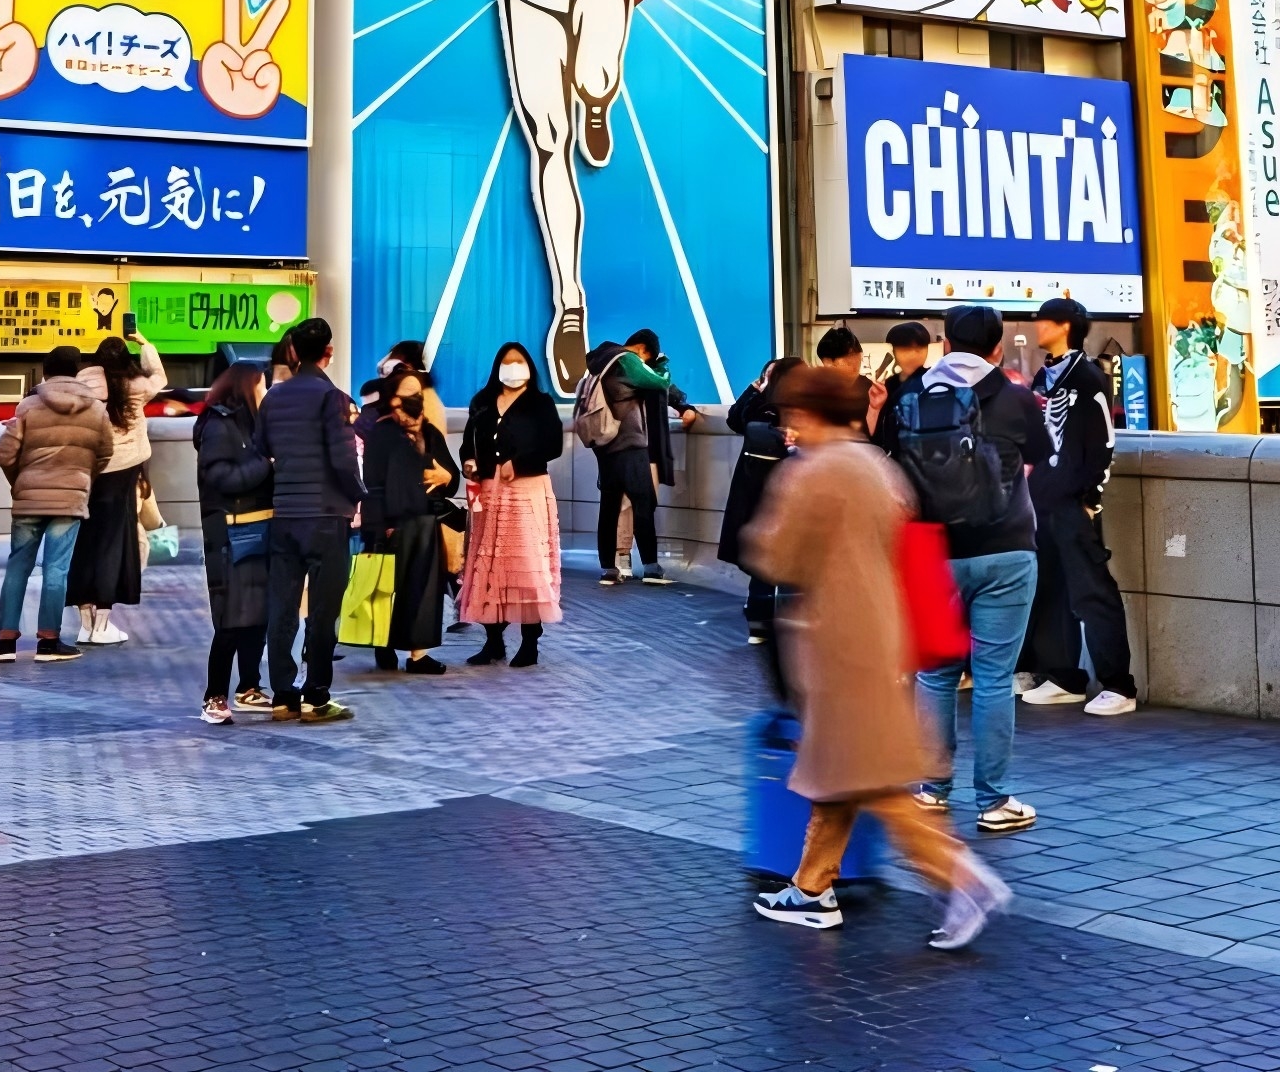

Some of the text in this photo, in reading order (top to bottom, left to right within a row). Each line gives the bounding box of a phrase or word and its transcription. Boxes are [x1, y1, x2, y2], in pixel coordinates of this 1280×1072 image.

[58, 31, 181, 59] ハイ!チーズ
